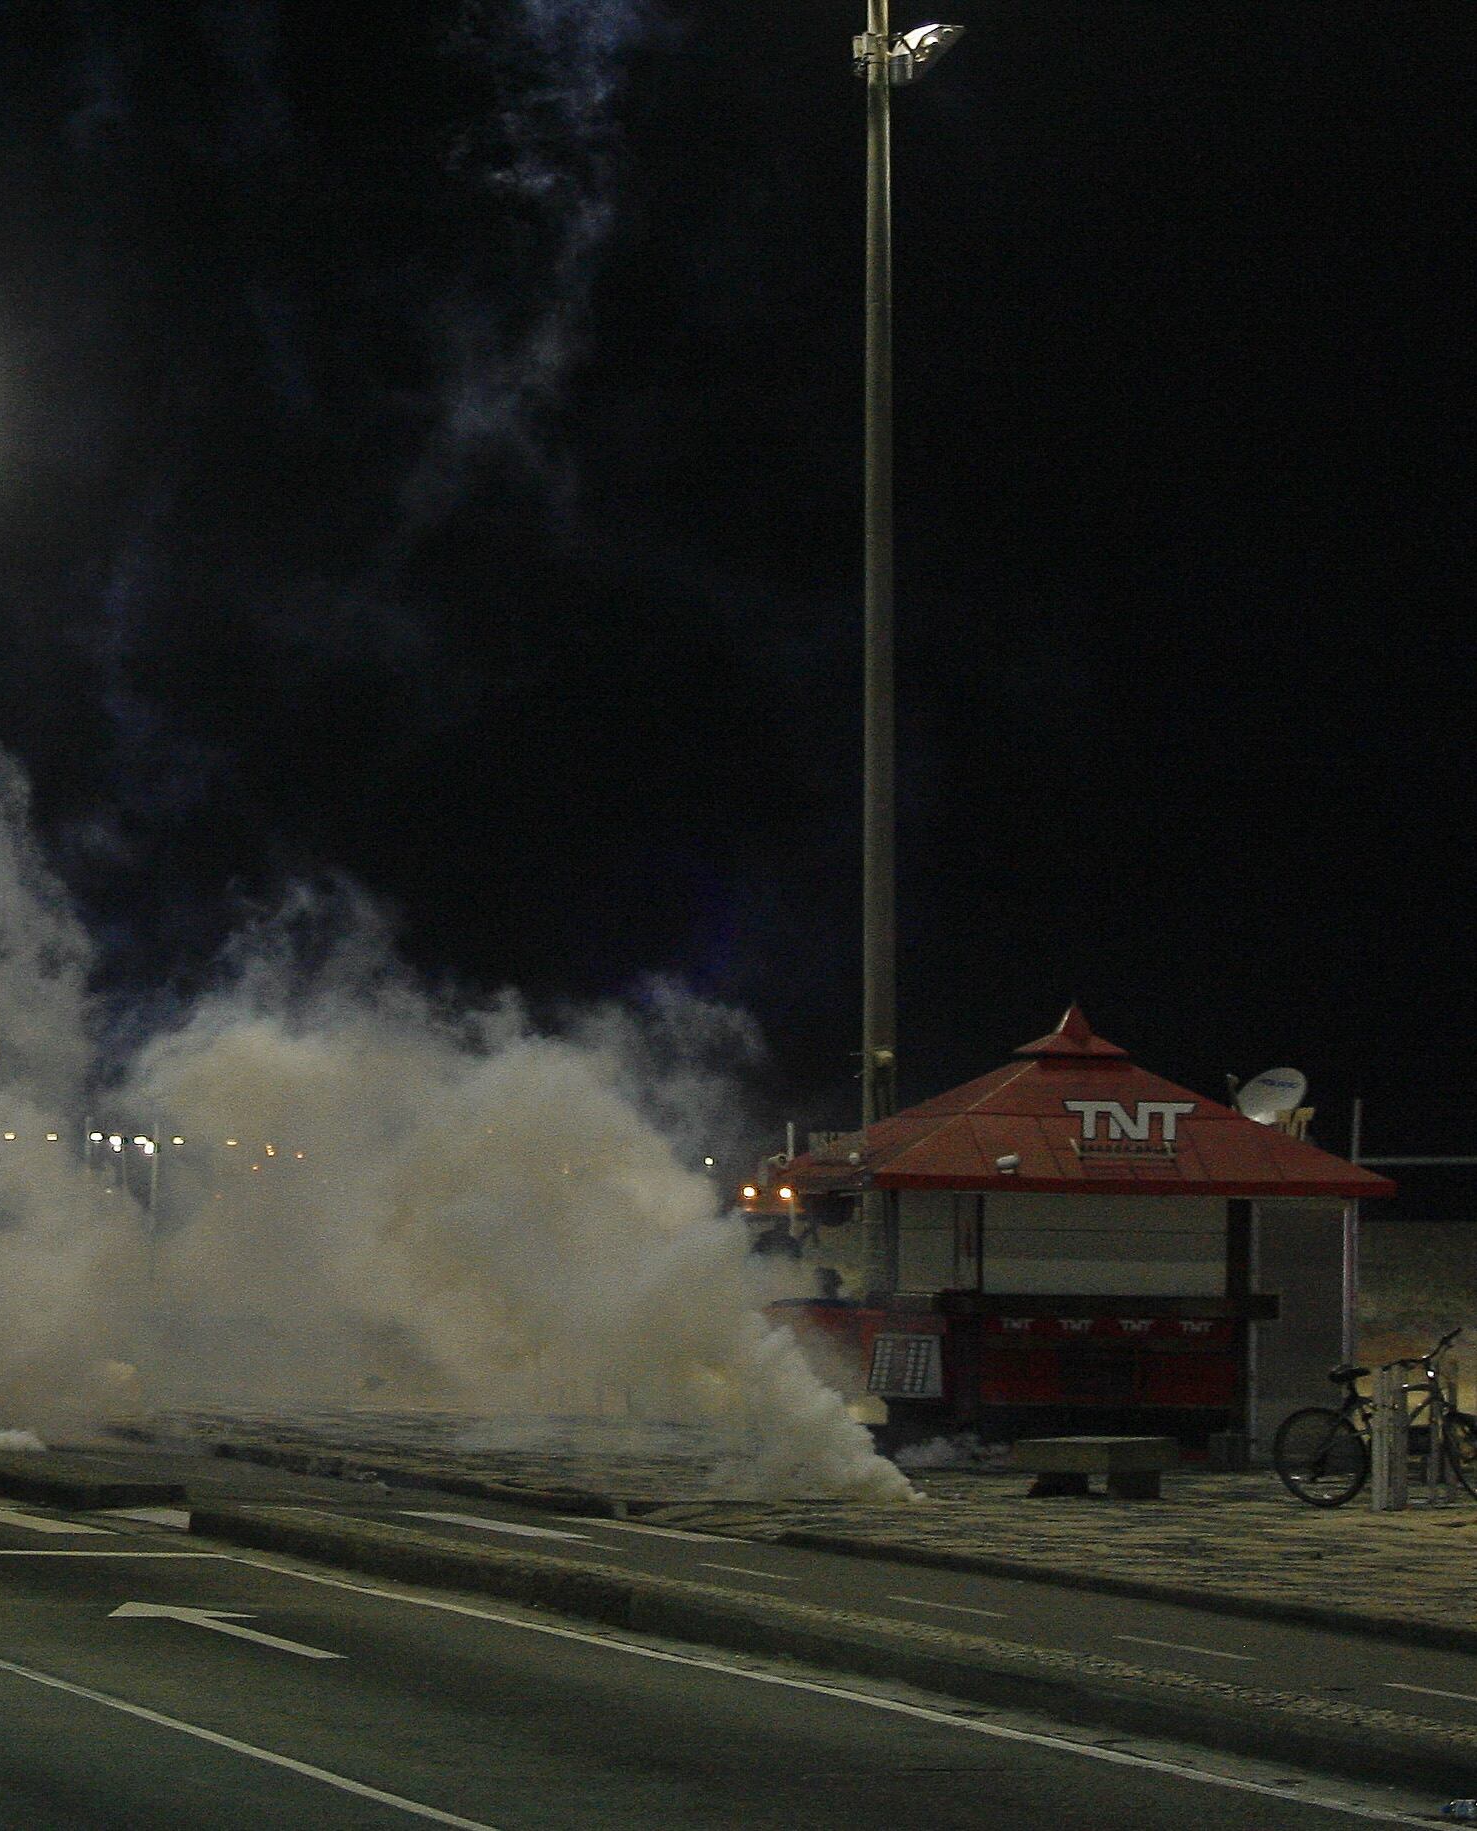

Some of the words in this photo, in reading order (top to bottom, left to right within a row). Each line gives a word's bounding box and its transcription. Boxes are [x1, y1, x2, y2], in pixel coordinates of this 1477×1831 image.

[1062, 1100, 1197, 1141] TNT
[1001, 1316, 1035, 1330] TNT
[1058, 1317, 1094, 1332] TNT
[1118, 1318, 1154, 1332] TNT
[1179, 1320, 1213, 1333] TNT
